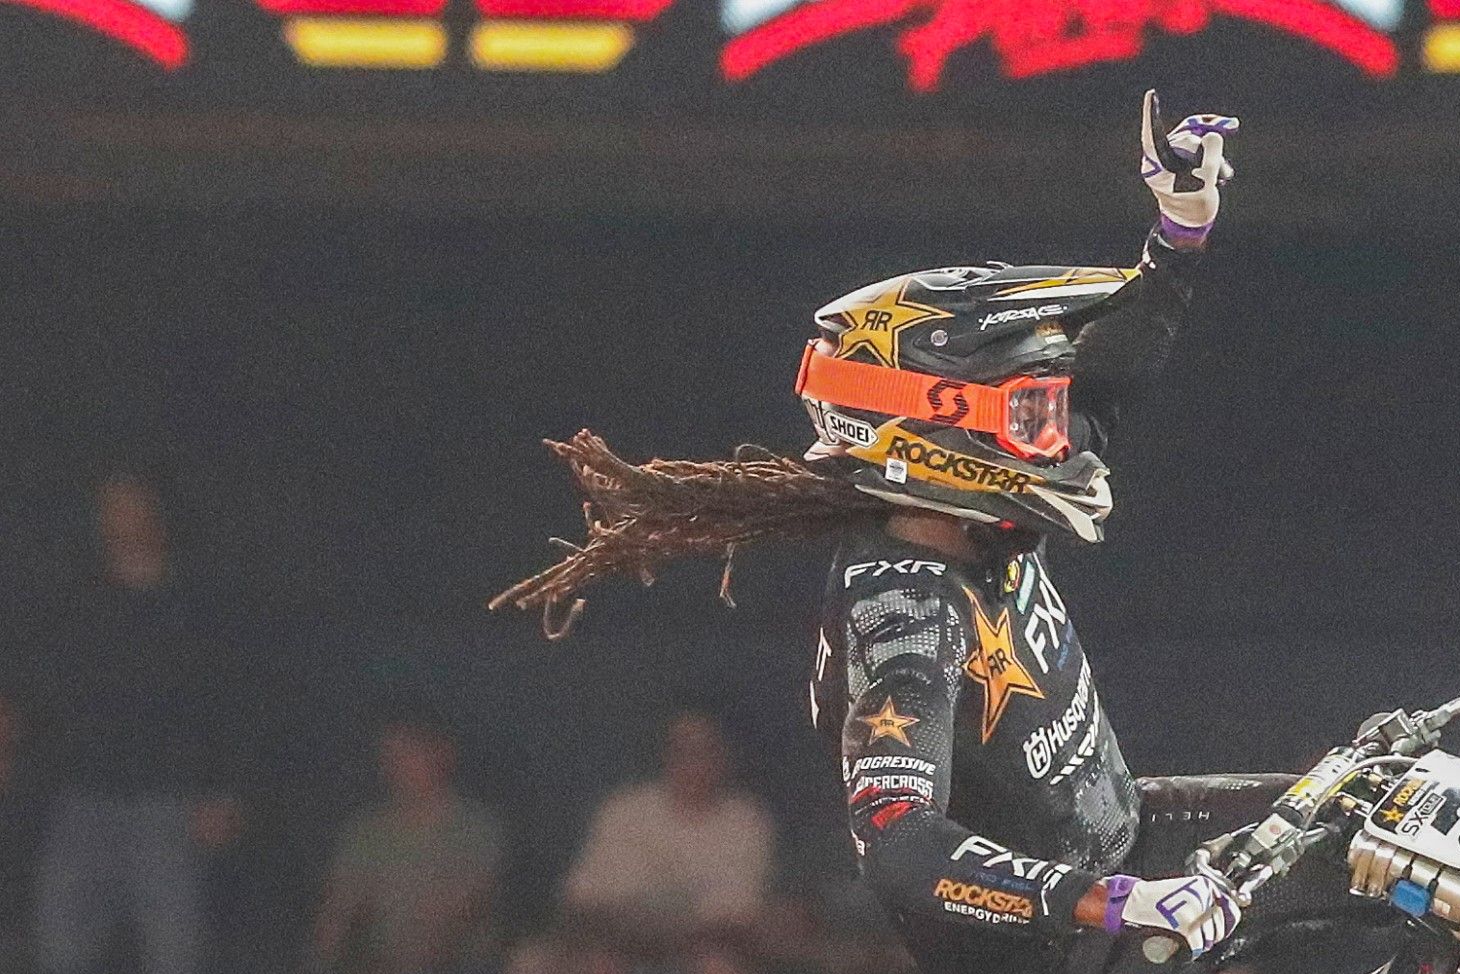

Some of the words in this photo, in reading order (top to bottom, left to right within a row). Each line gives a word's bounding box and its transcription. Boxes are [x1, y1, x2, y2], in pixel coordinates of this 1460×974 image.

[830, 416, 869, 443] SHOEI
[886, 436, 1032, 493] ROCKSTAR
[844, 558, 947, 589] FXR
[1024, 551, 1067, 675] FX
